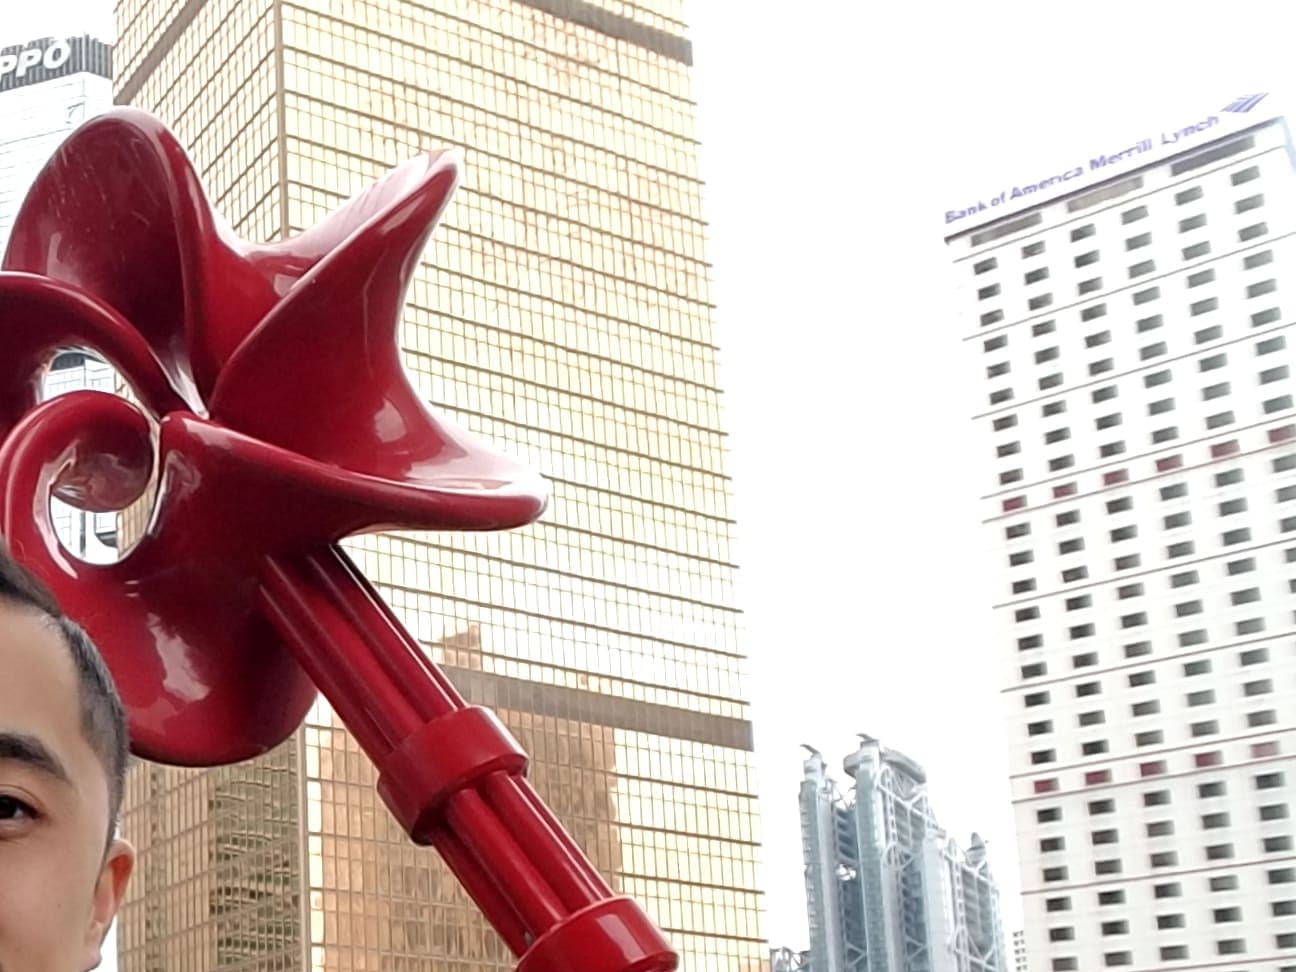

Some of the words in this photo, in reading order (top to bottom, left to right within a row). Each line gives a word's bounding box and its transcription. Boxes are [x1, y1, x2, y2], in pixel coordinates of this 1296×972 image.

[944, 199, 987, 224] Bank
[991, 191, 1007, 207] of
[1010, 166, 1084, 200] America
[1089, 138, 1152, 171] Merrill
[1161, 114, 1220, 146] Lynch
